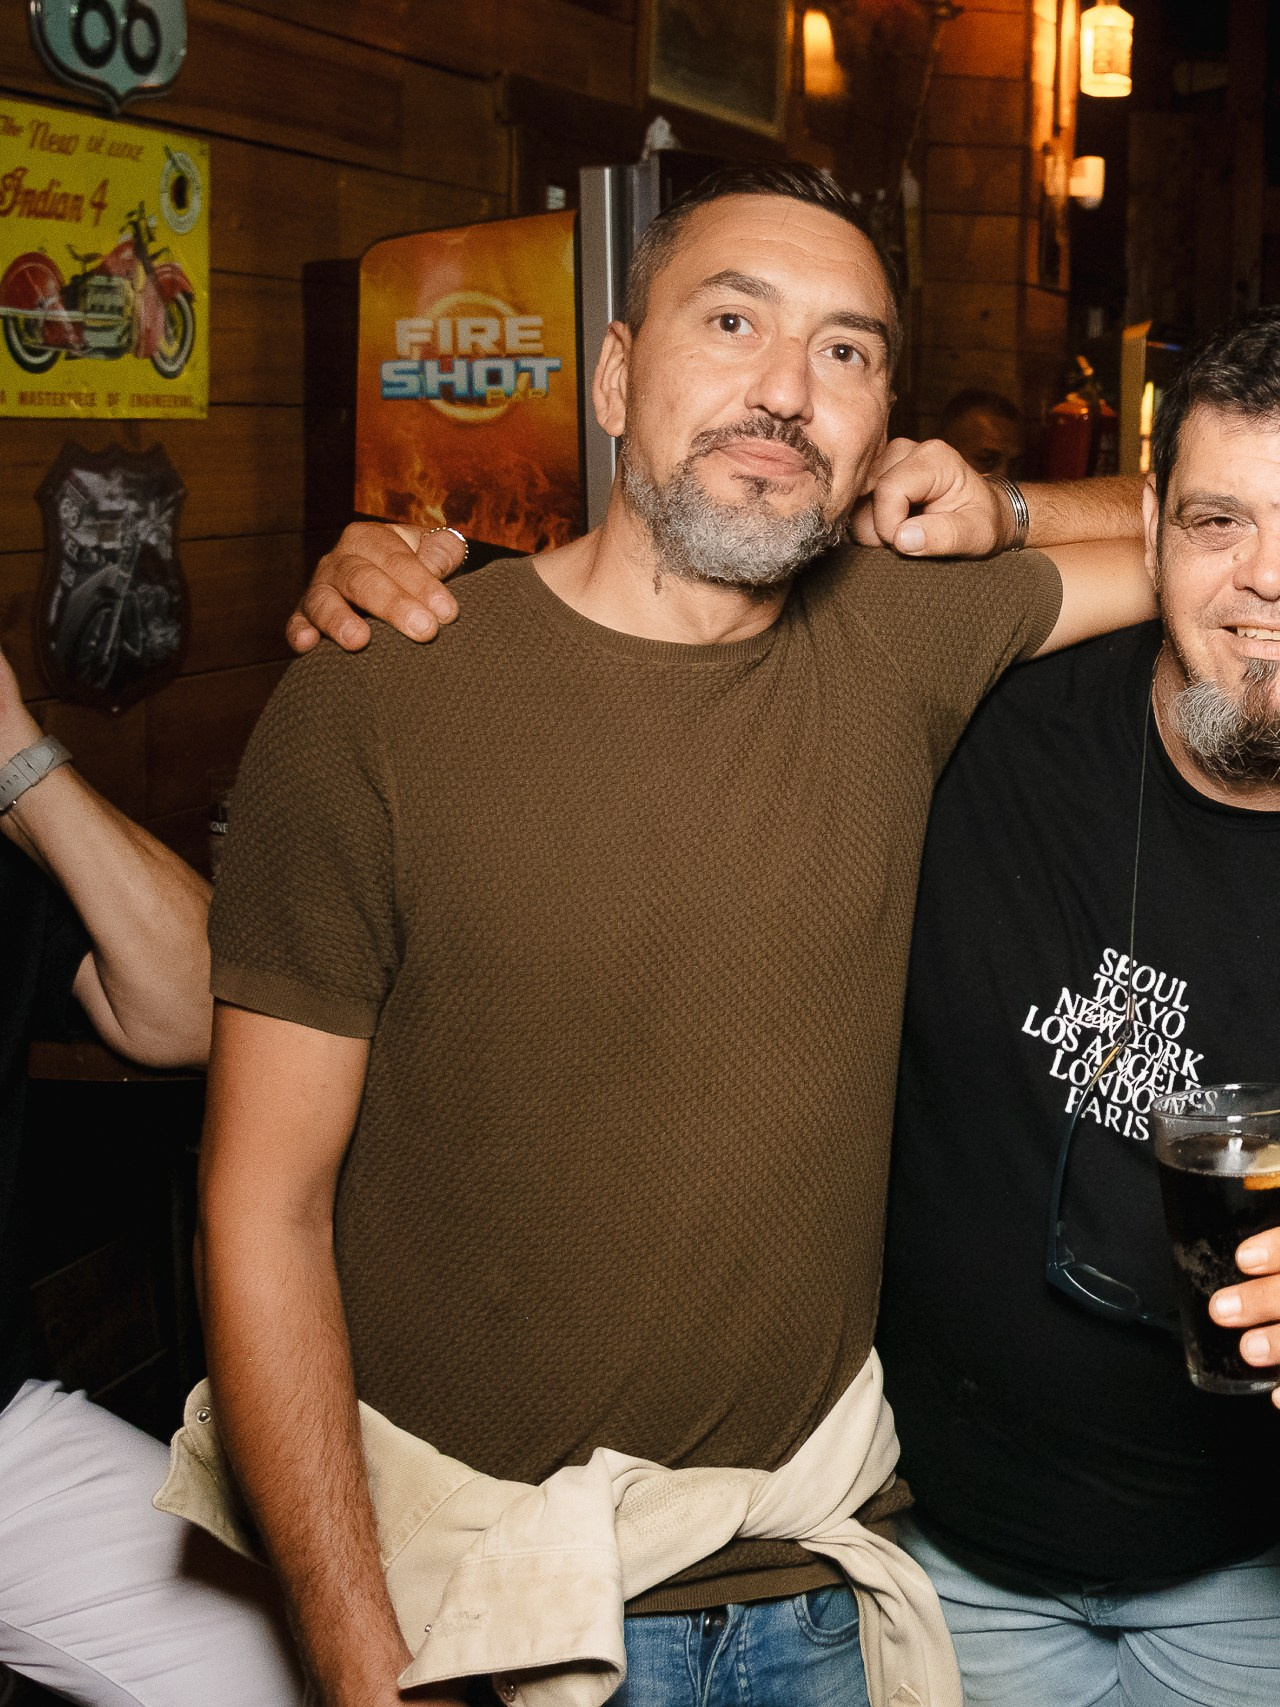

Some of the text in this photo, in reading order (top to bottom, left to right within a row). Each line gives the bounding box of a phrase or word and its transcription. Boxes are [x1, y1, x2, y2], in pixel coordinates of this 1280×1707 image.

[0, 166, 109, 227] Indian 4
[395, 316, 544, 358] FIRE
[380, 357, 562, 400] SHOT
[1093, 973, 1186, 1039] TOKYO
[1099, 947, 1189, 1012] SEOUL
[1021, 1005, 1082, 1052] LOS
[1054, 987, 1126, 1041] NEW
[1128, 1020, 1204, 1081] YORK
[1064, 1086, 1150, 1141] PARIS
